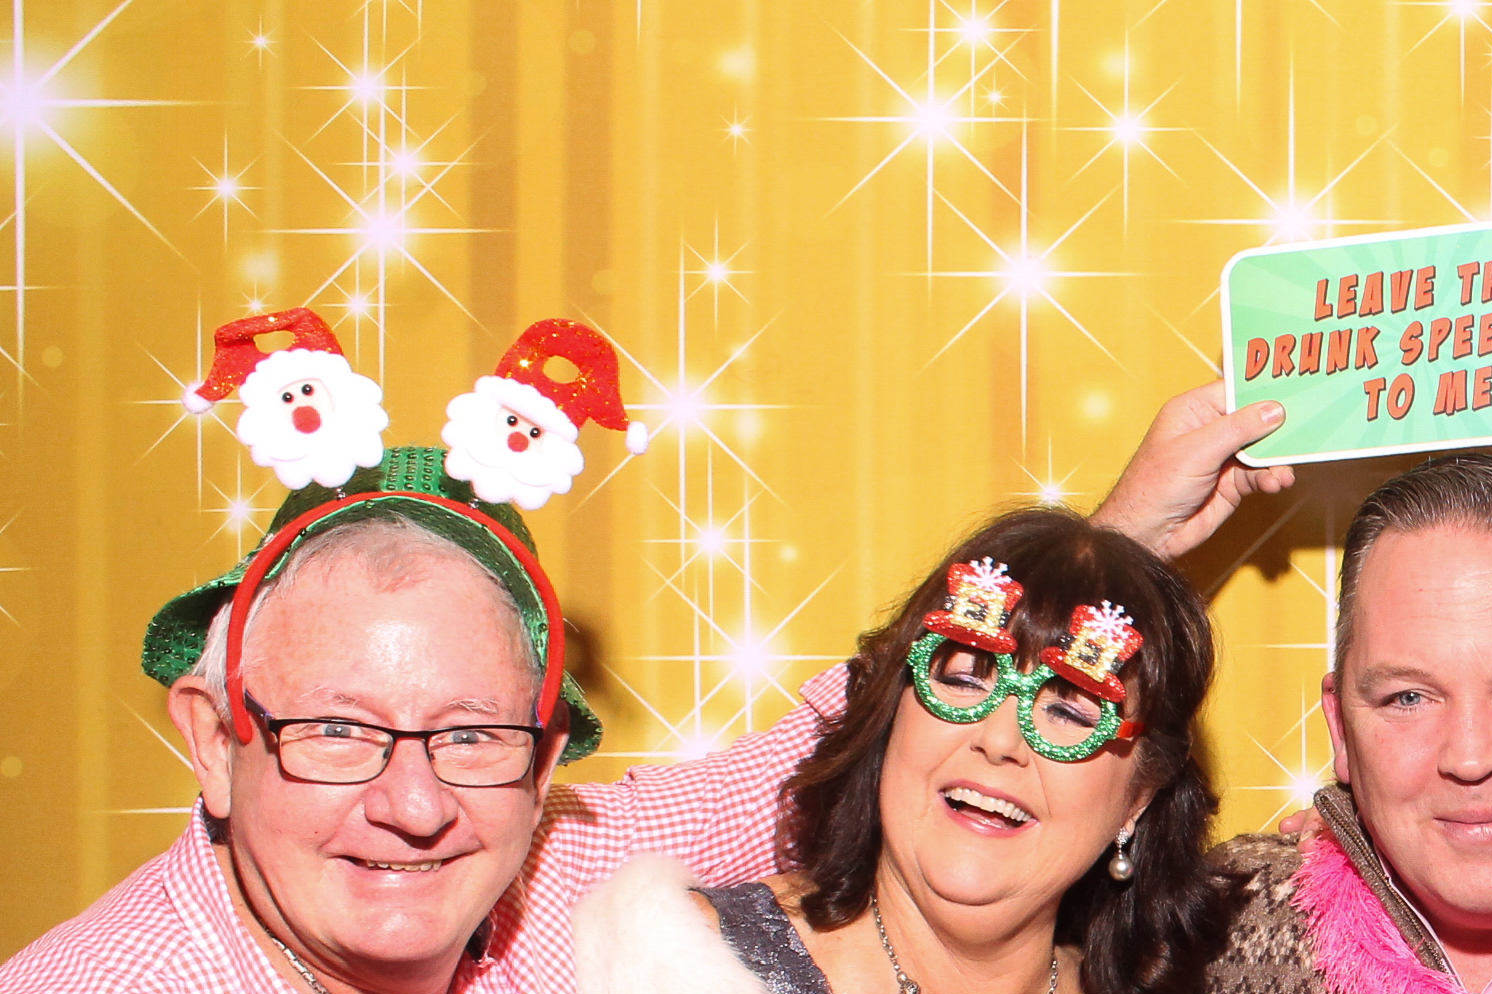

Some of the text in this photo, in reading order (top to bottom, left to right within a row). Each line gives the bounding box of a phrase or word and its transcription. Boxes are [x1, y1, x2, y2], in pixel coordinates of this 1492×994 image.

[1314, 266, 1436, 321] LEAVE
[1245, 327, 1380, 381] DRUNK
[1363, 372, 1415, 421] TO
